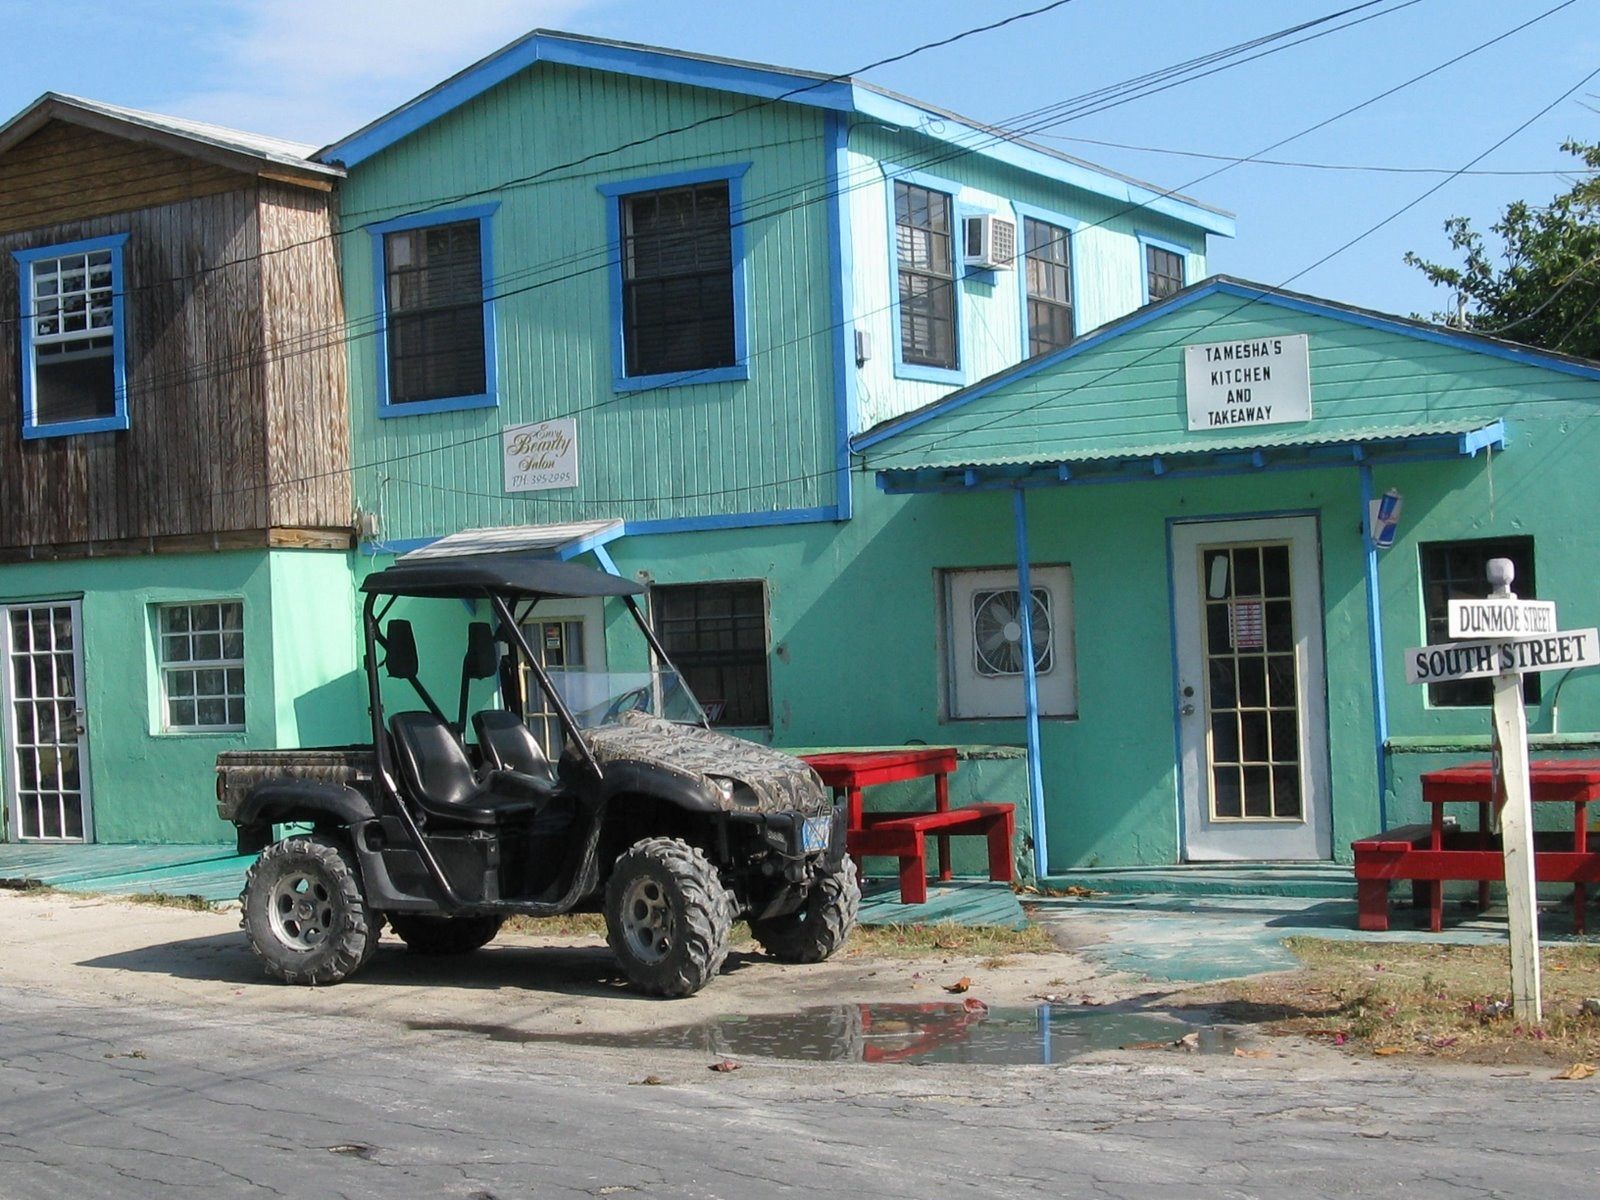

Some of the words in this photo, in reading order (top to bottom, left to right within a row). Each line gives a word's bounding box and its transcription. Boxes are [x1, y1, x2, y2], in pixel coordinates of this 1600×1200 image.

[1205, 340, 1282, 362] TAMESHA'S
[1210, 366, 1271, 386] KITCHEN
[1226, 388, 1252, 404] AND
[1208, 405, 1272, 426] TAKEAWAY
[507, 432, 571, 457] Beauty
[518, 452, 555, 472] Salon
[1459, 605, 1520, 633] DUNMOE
[1523, 606, 1552, 633] STREET
[1416, 645, 1494, 679] SOUTH
[1501, 634, 1587, 671] STREET
